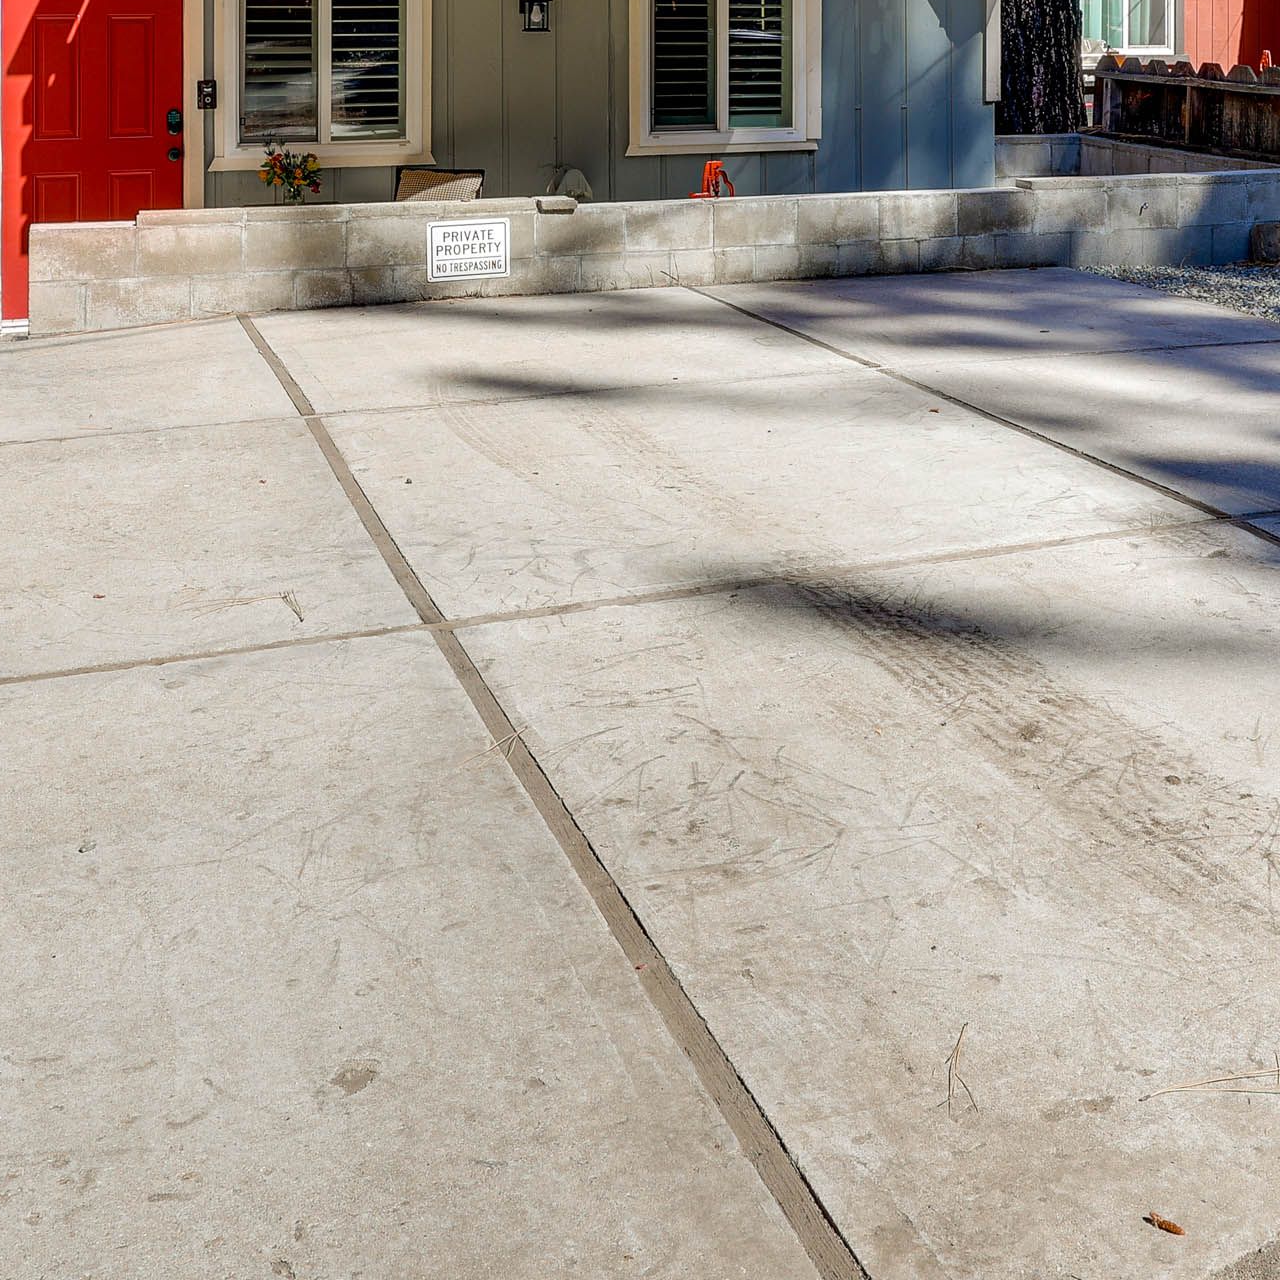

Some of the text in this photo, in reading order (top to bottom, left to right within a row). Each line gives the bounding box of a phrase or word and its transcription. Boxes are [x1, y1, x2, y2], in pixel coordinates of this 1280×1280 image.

[442, 229, 495, 242] PRIVATE
[436, 241, 502, 256] PROPERTY
[436, 260, 502, 273] NO TRESPASSING
